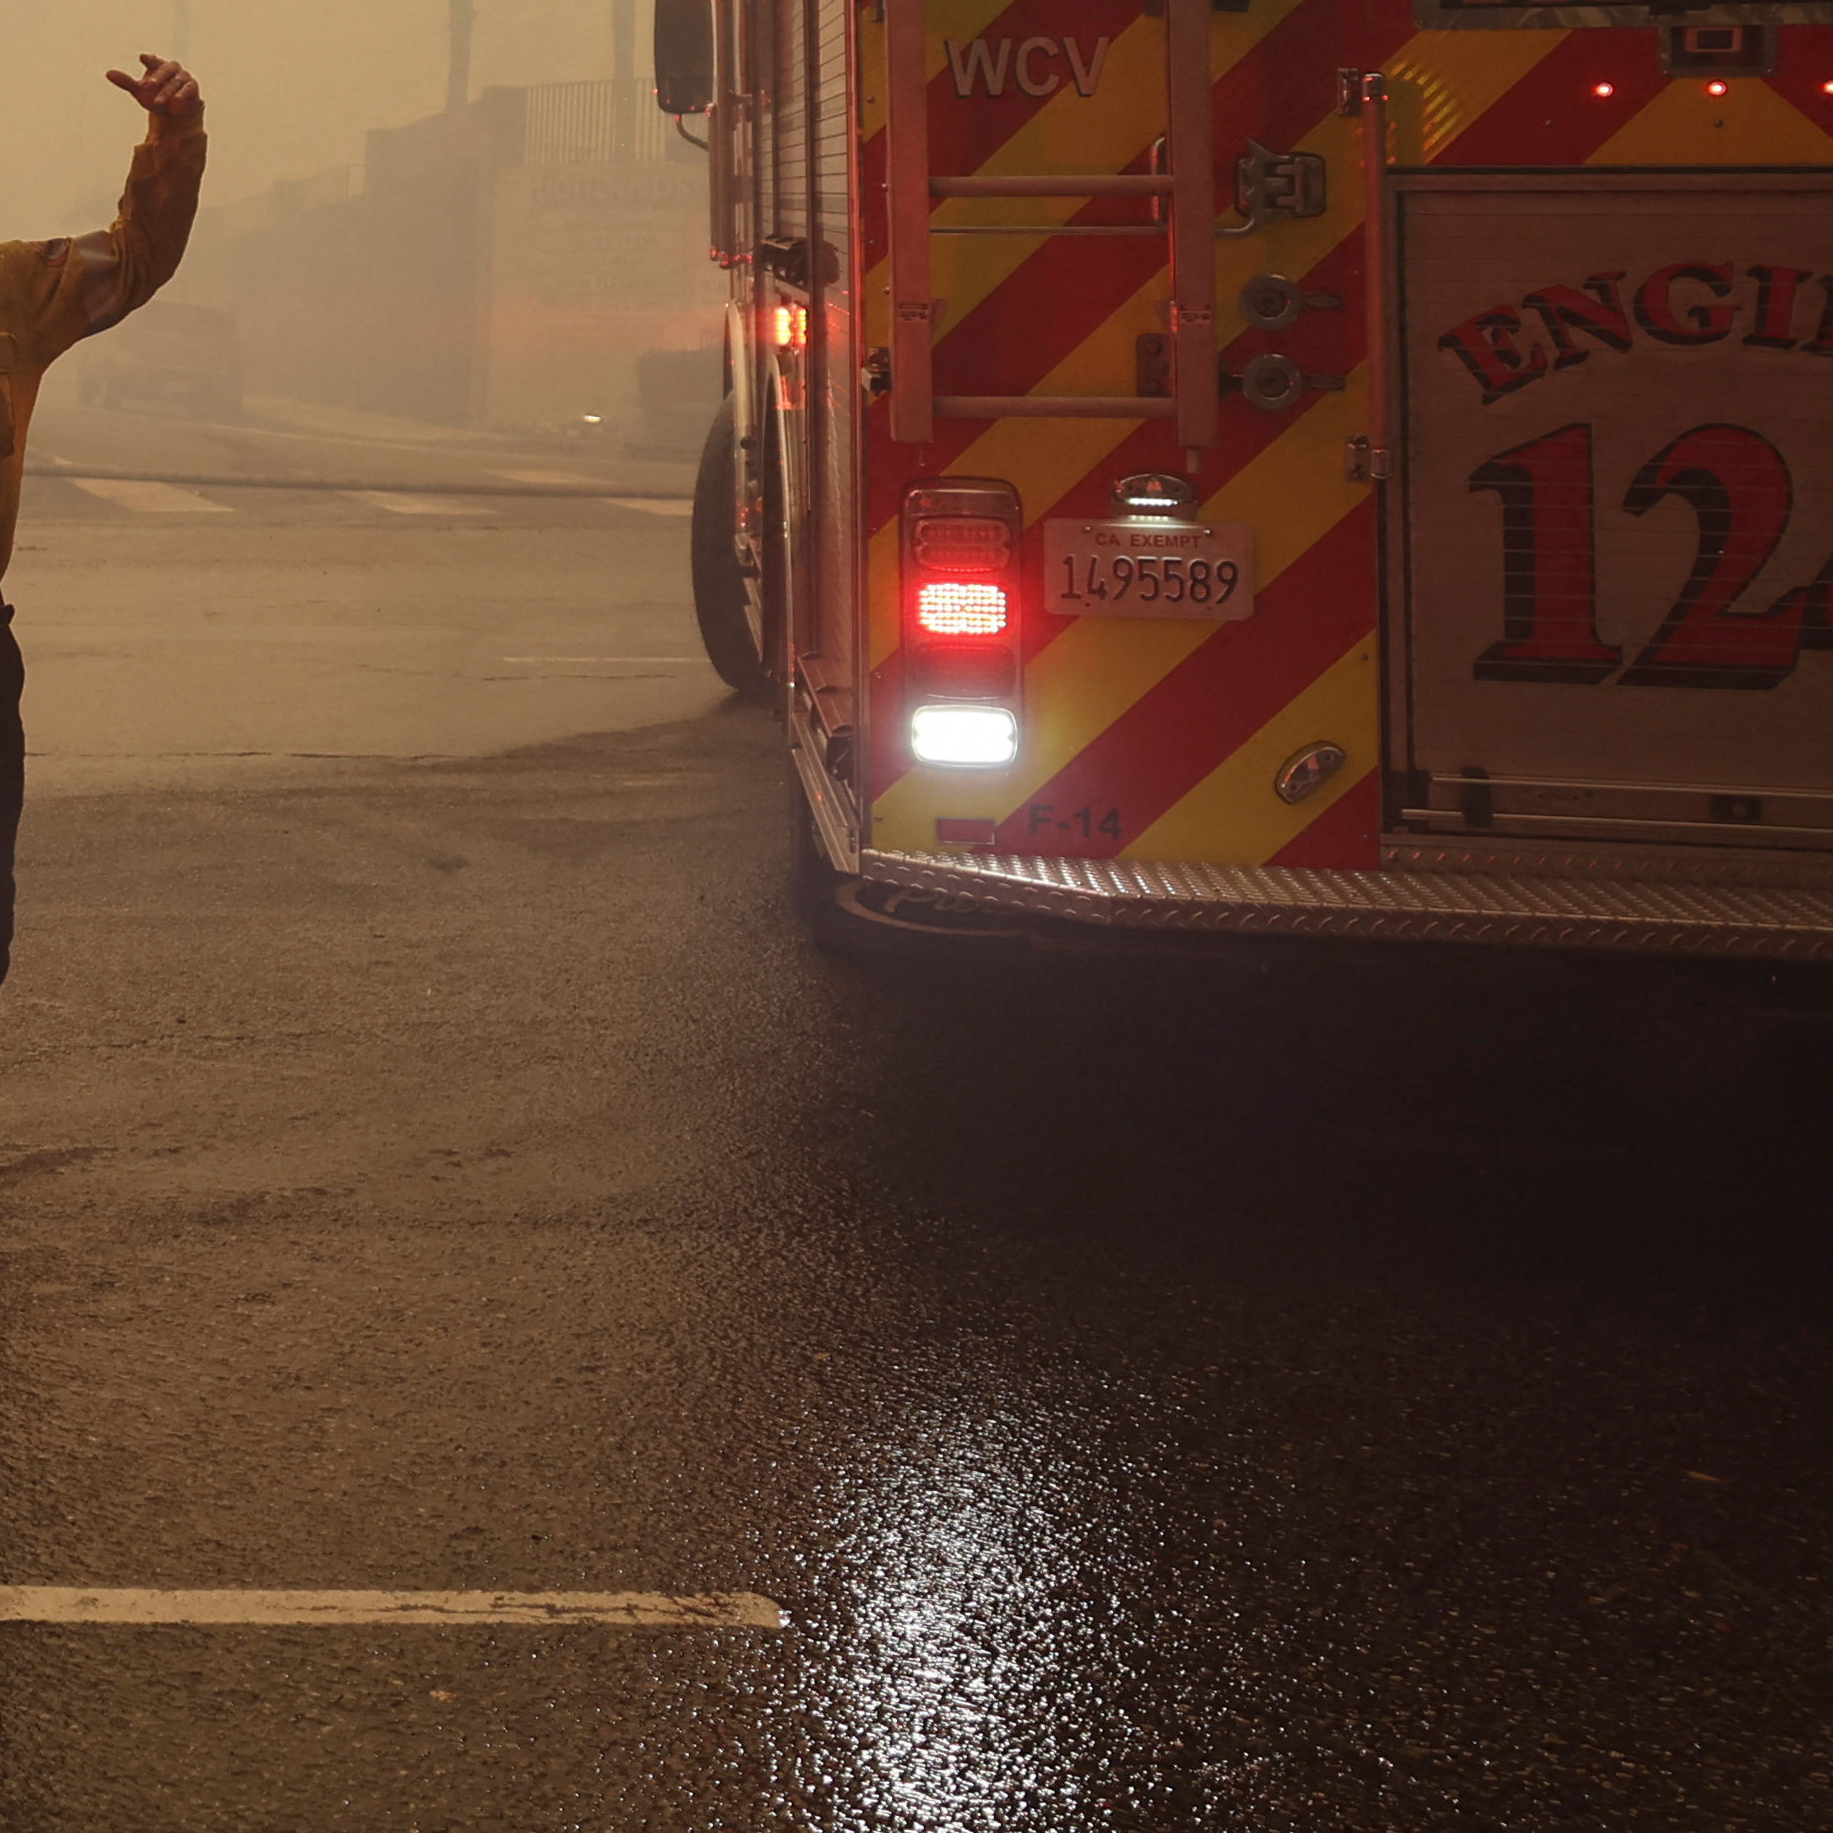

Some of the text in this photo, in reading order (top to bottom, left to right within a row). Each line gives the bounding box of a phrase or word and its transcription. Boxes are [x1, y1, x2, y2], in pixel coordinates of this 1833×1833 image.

[944, 36, 1111, 98] WCV
[1095, 532, 1202, 549] CA EXEMPT
[1468, 422, 1833, 691] 12
[1061, 553, 1239, 604] 1495589
[1028, 804, 1124, 841] F-14
